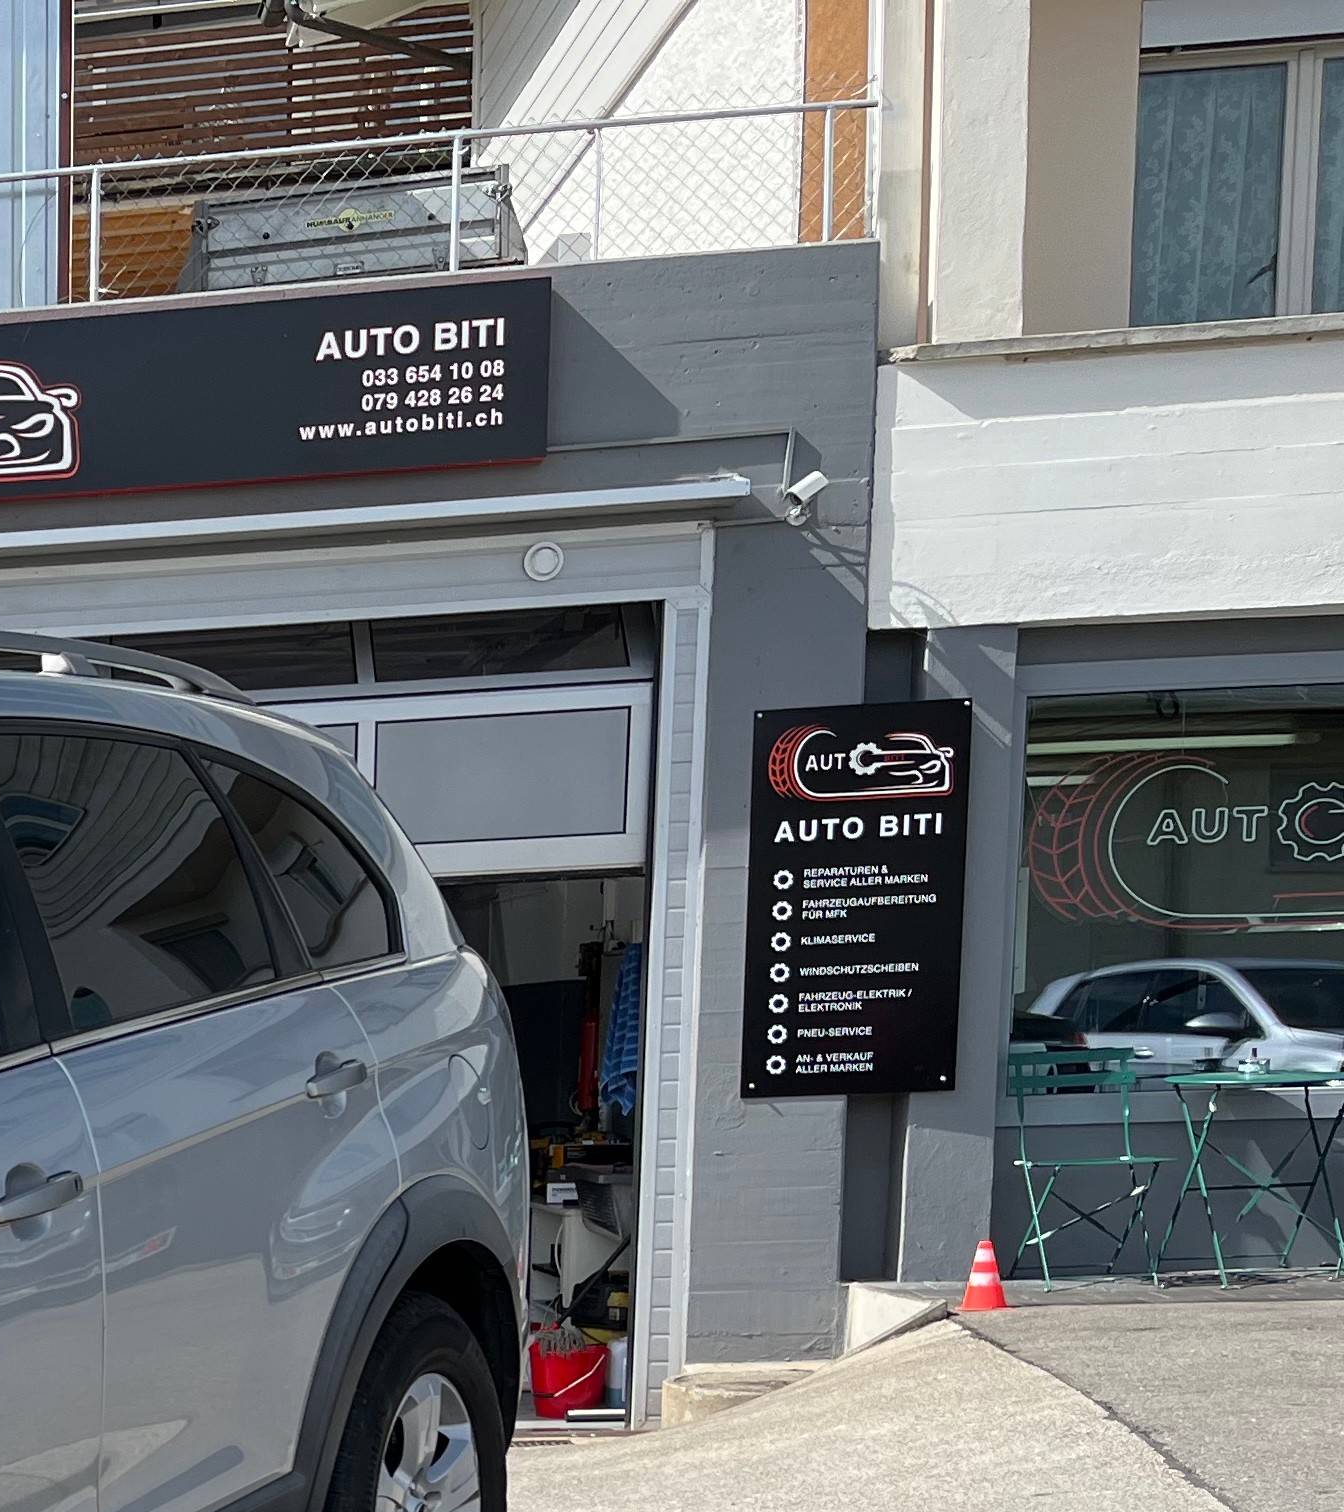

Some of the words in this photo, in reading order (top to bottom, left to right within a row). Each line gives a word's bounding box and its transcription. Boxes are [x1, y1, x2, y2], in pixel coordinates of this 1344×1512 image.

[315, 324, 420, 362] AUTO
[434, 317, 505, 351] BITI
[362, 367, 399, 387] 033
[405, 364, 442, 384] 654
[449, 361, 473, 380] 10
[480, 359, 505, 378] 08
[361, 392, 399, 412] 079
[404, 389, 442, 408] 428
[448, 386, 473, 404] 26
[479, 384, 504, 402] 24
[299, 408, 504, 441] www.autobiti.ch
[773, 816, 864, 843] AUTO
[879, 812, 943, 838] BITI
[803, 865, 879, 878] REPARATUREN
[880, 864, 889, 874] &
[803, 877, 848, 889] SERVICE
[849, 875, 883, 887] ALLER
[884, 873, 929, 885] MARKEN
[802, 893, 937, 909] FAHRZEUGAUFBEREITUNG
[801, 908, 823, 920] FÜR
[825, 908, 848, 919] MFK
[800, 933, 876, 946] KLIMASERVICE
[799, 962, 920, 977] WINDSCHUTZSCHEIBEN
[798, 988, 907, 1002] FAHRZEUG-ELEKTRIK
[798, 1001, 863, 1013] ELEKTRONIK
[797, 1026, 873, 1038] PNEU-SERVICE
[815, 1053, 824, 1063] &
[825, 1051, 874, 1062] VERKAUF
[795, 1064, 828, 1074] ALLER
[829, 1062, 874, 1073] MARKEN
